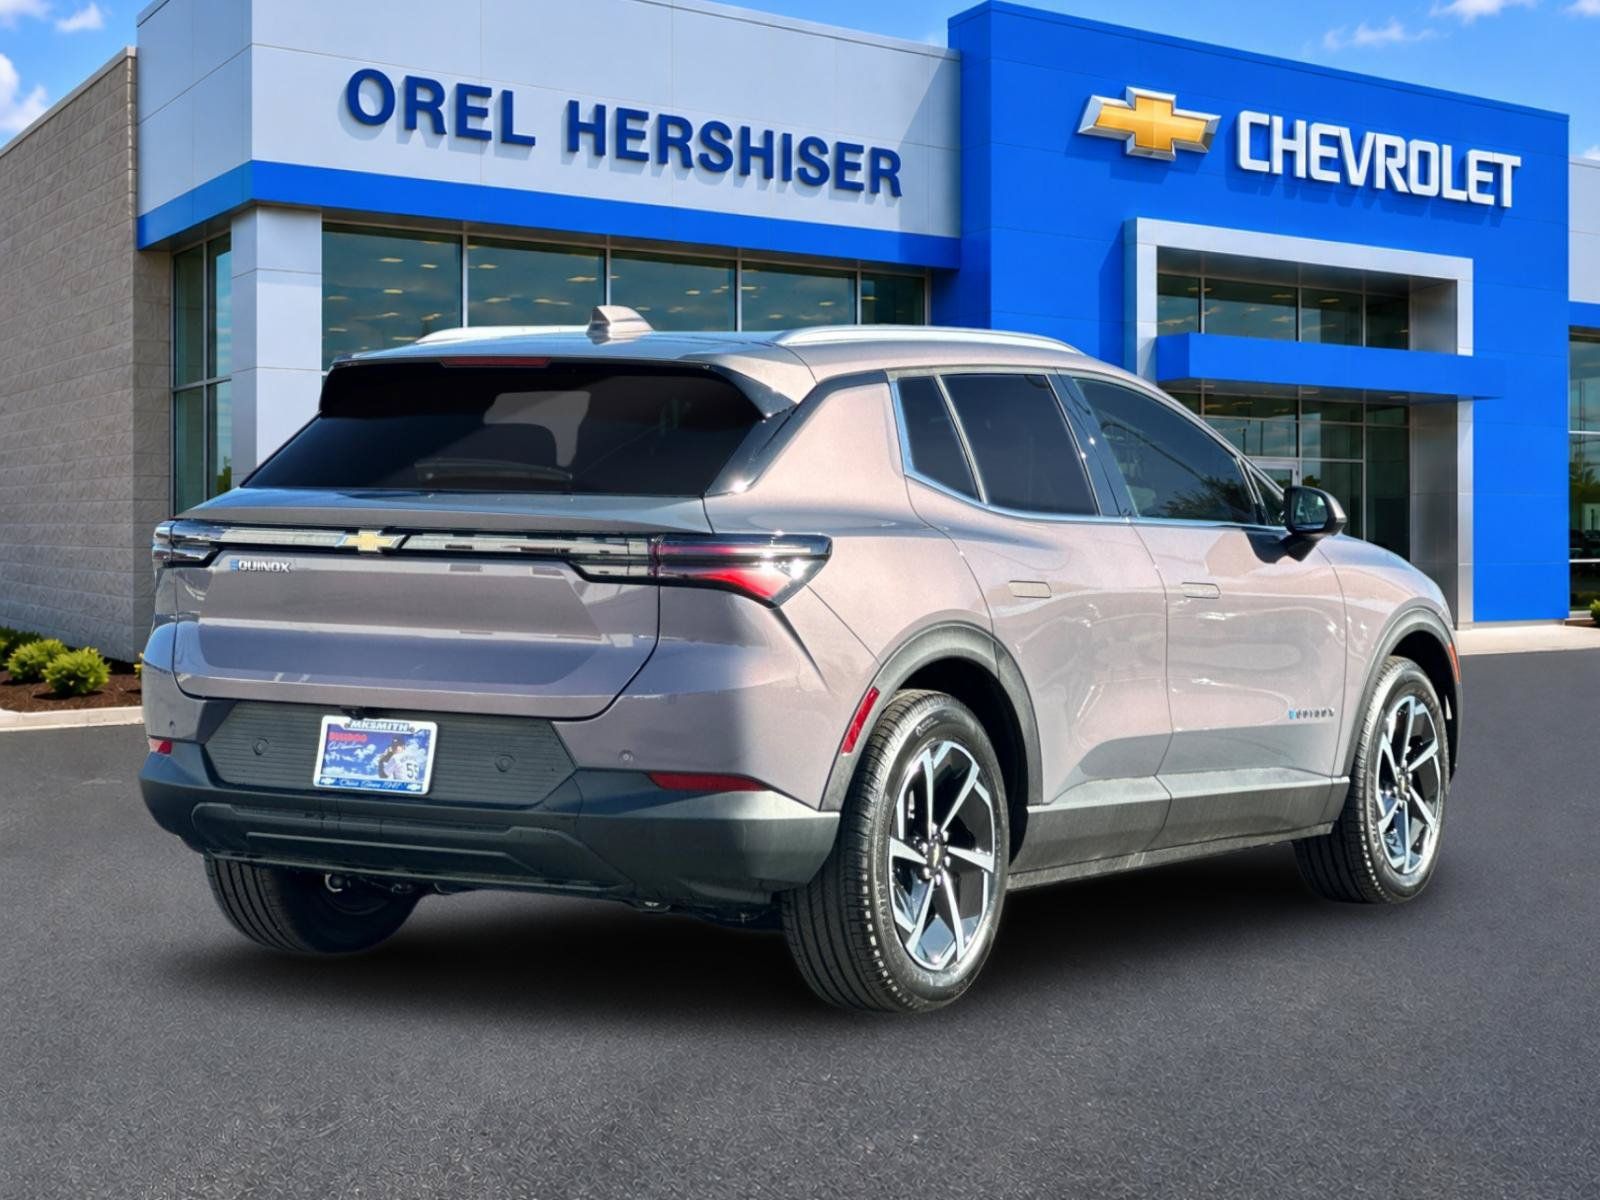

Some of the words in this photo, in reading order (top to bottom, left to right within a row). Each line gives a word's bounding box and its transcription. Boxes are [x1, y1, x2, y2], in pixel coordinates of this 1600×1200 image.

[346, 68, 536, 147] OREL
[567, 100, 902, 197] HERSHISER
[1238, 110, 1521, 208] CHEVROLET
[230, 559, 290, 573] EQUINOX
